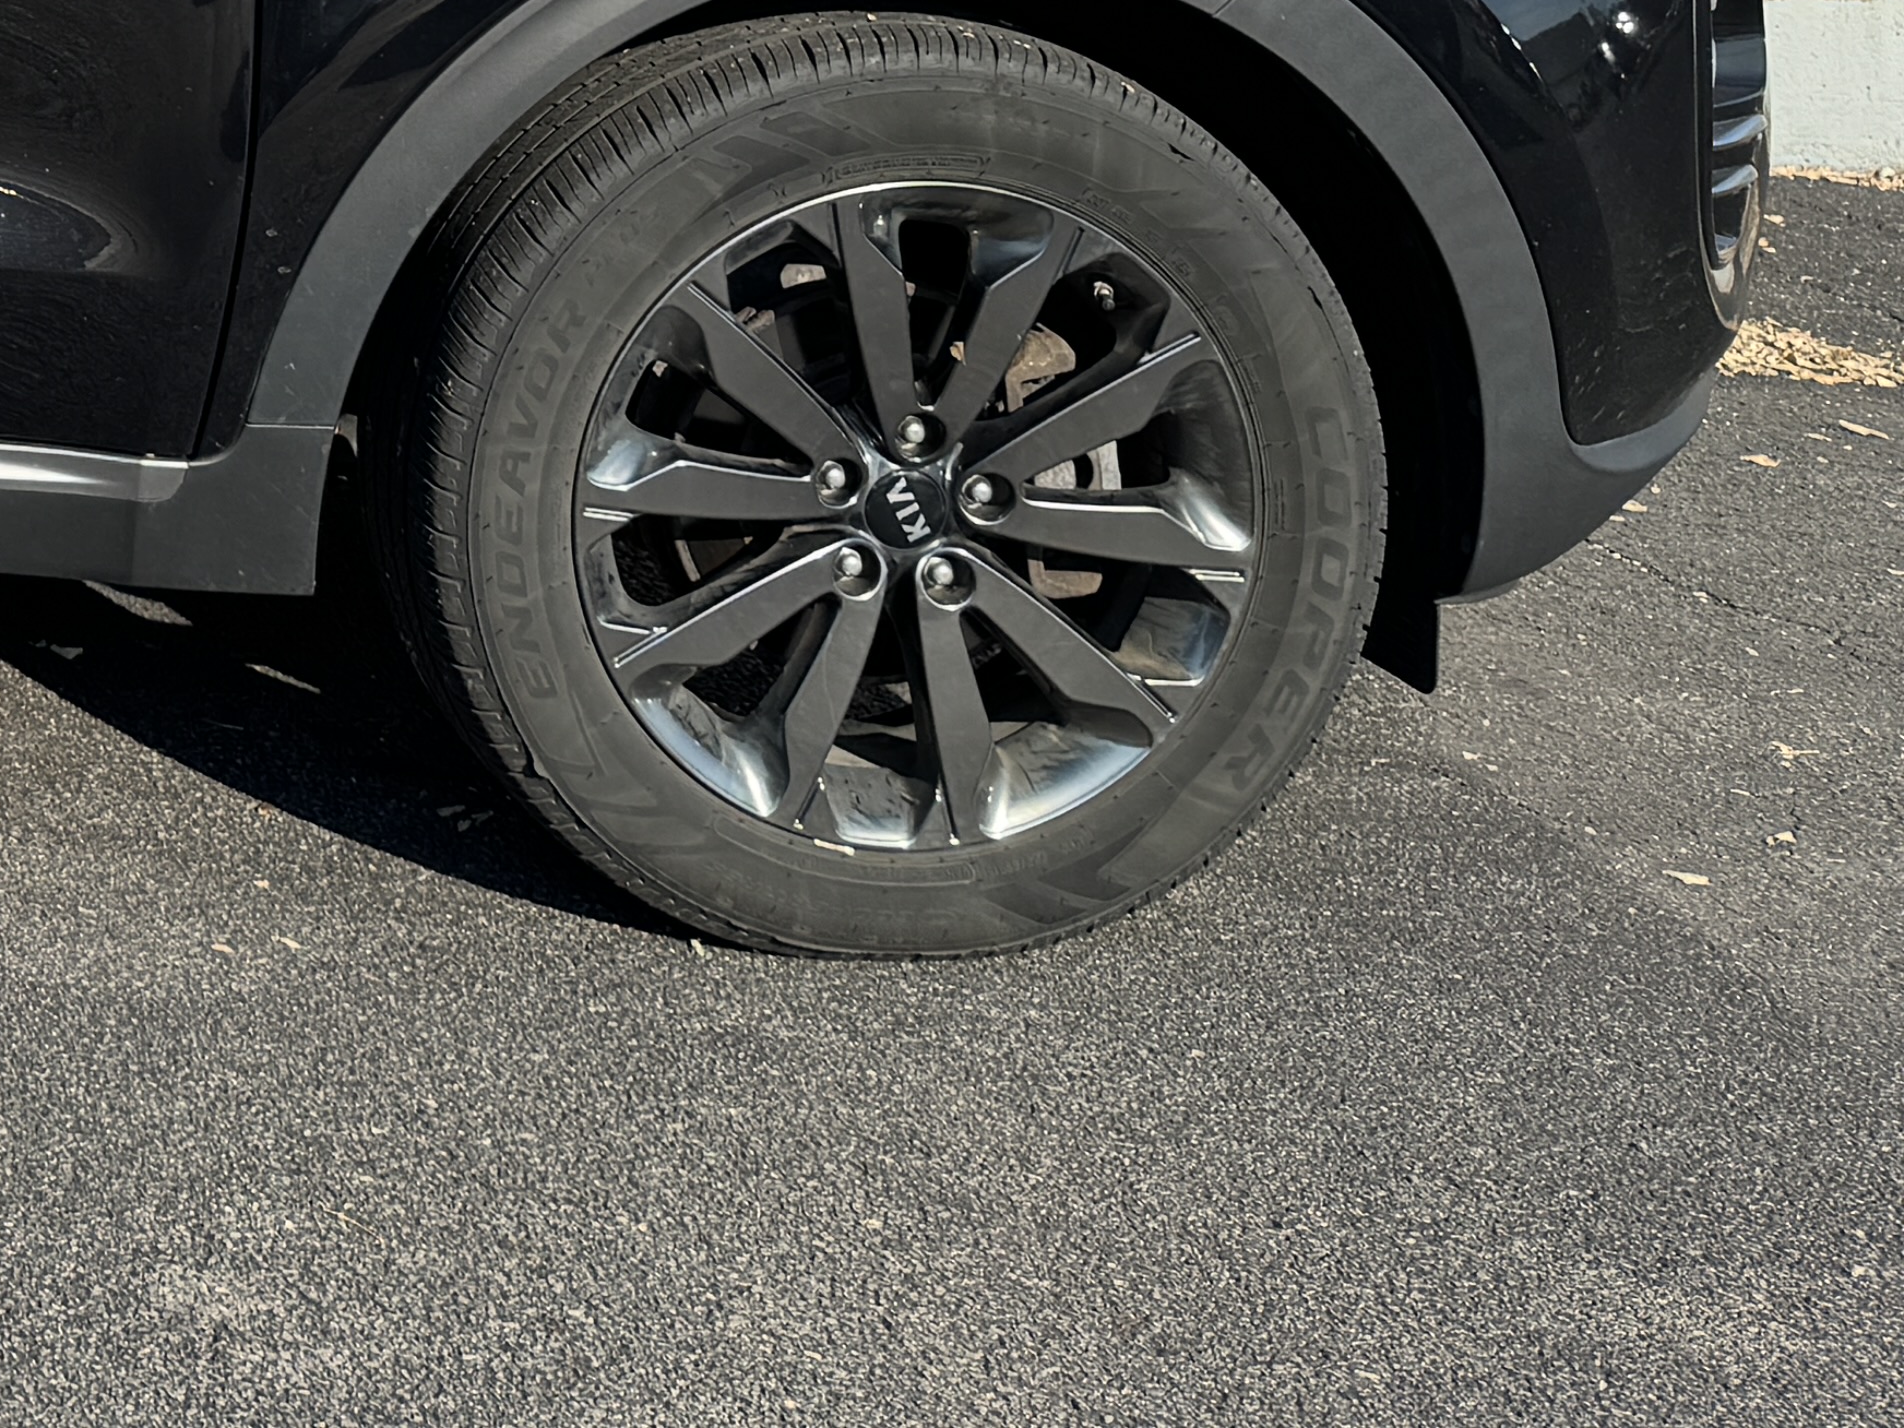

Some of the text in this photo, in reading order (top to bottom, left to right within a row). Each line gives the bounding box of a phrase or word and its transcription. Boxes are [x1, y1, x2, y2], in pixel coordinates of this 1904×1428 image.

[495, 296, 587, 700] ENDEAVOR
[886, 476, 931, 543] KIA
[1223, 405, 1353, 792] COOPER
